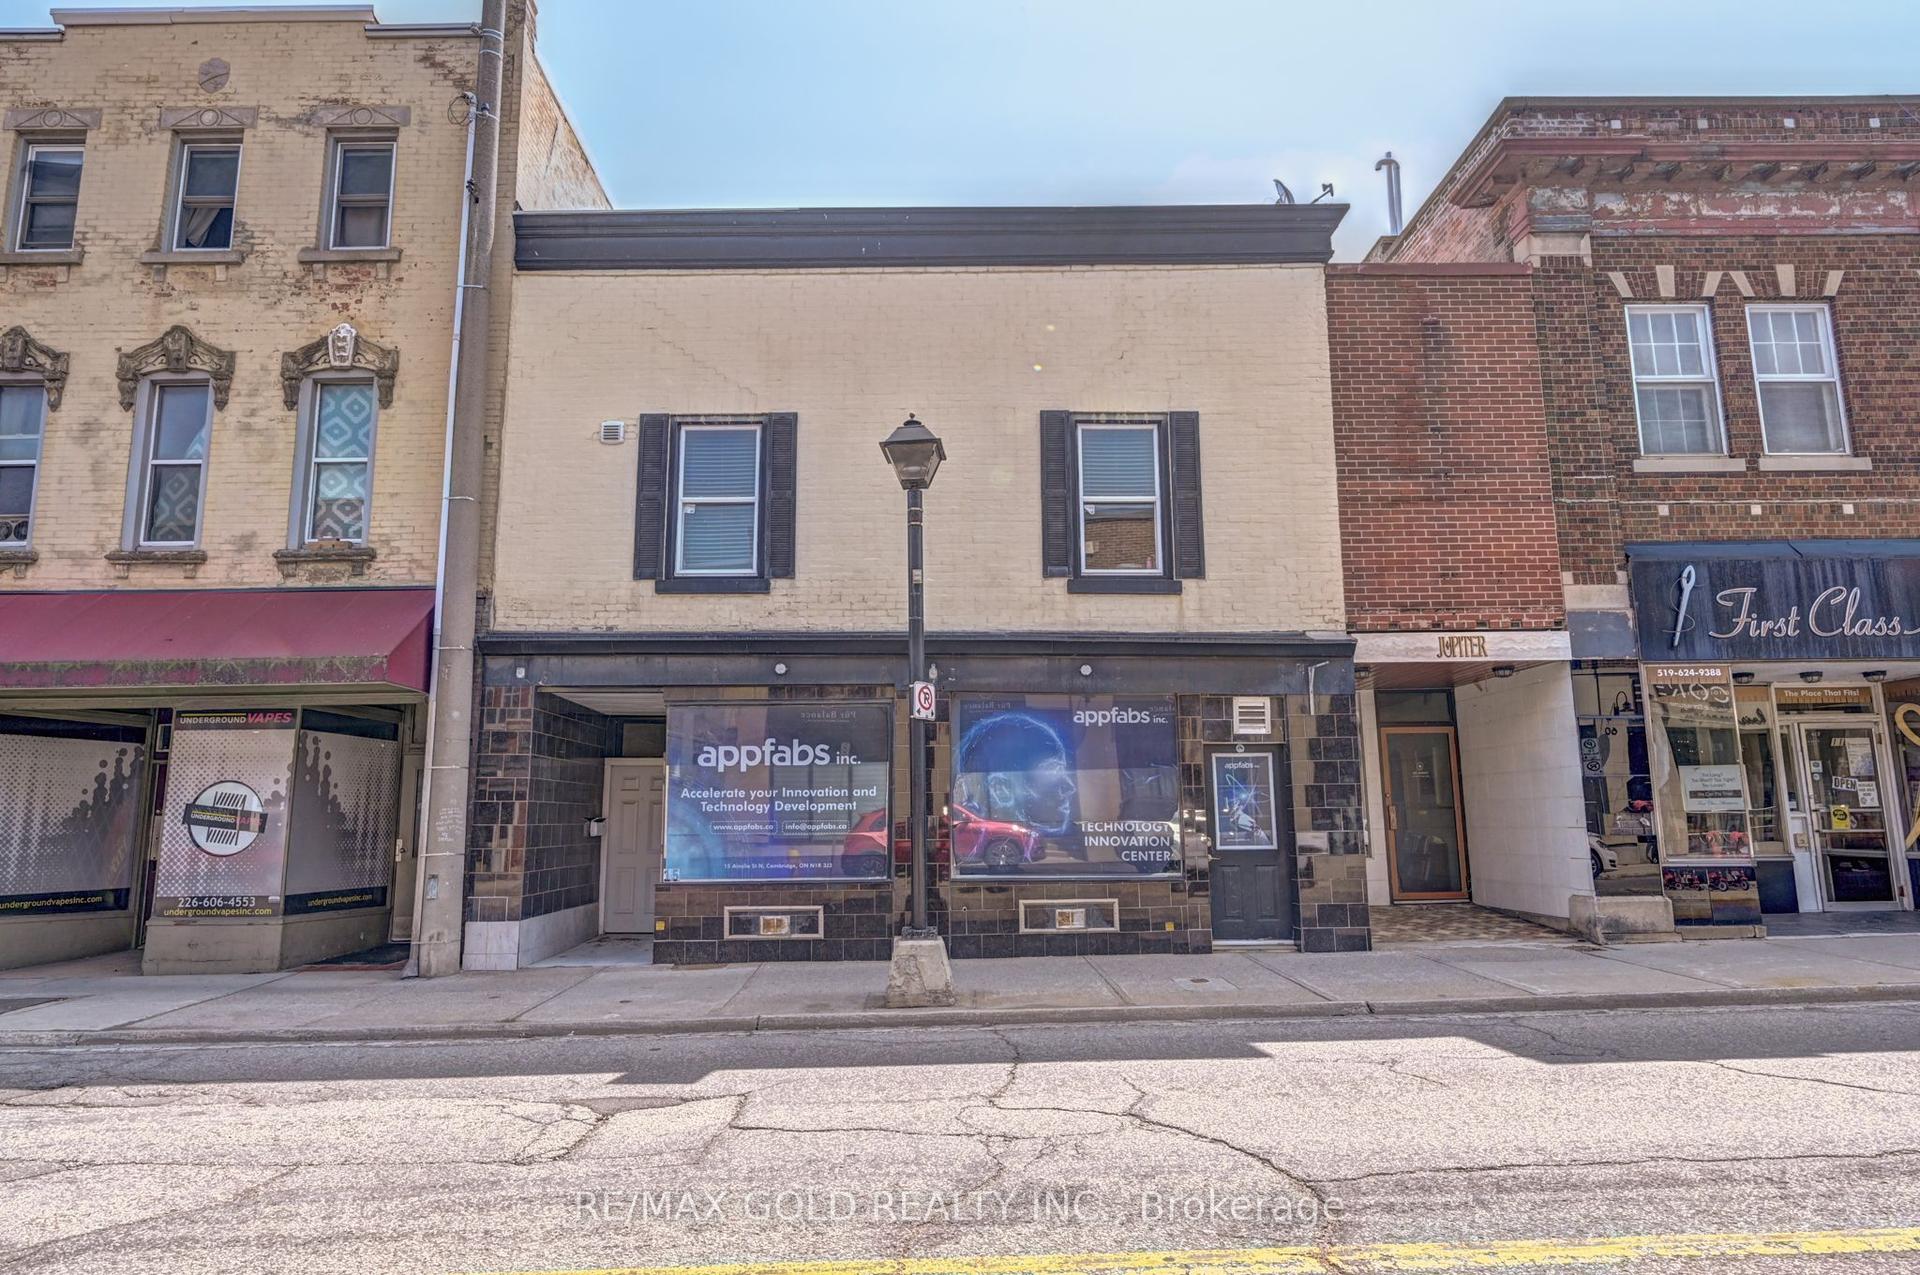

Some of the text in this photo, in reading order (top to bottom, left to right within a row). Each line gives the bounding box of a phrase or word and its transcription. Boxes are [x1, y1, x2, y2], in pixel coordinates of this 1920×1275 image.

[1709, 586, 1900, 637] First Class
[1436, 635, 1489, 658] JUPITER
[1657, 668, 1722, 677] 519-624-9388
[180, 712, 293, 725] UNDERGROUND VAPES
[1073, 707, 1151, 727] appfabs
[1153, 715, 1169, 724] inc.
[697, 737, 862, 773] appfabs inc.
[1834, 778, 1857, 790] OPEN
[680, 786, 877, 800] Accelerate your Innovation and
[701, 800, 857, 814] Technology Development
[1081, 822, 1169, 832] TECHNOLOGY
[1084, 836, 1170, 847] INNOVATION
[1121, 850, 1171, 861] CENTER
[178, 896, 256, 908] 226-606-4553
[164, 907, 272, 917] undergroundvapesinc.com
